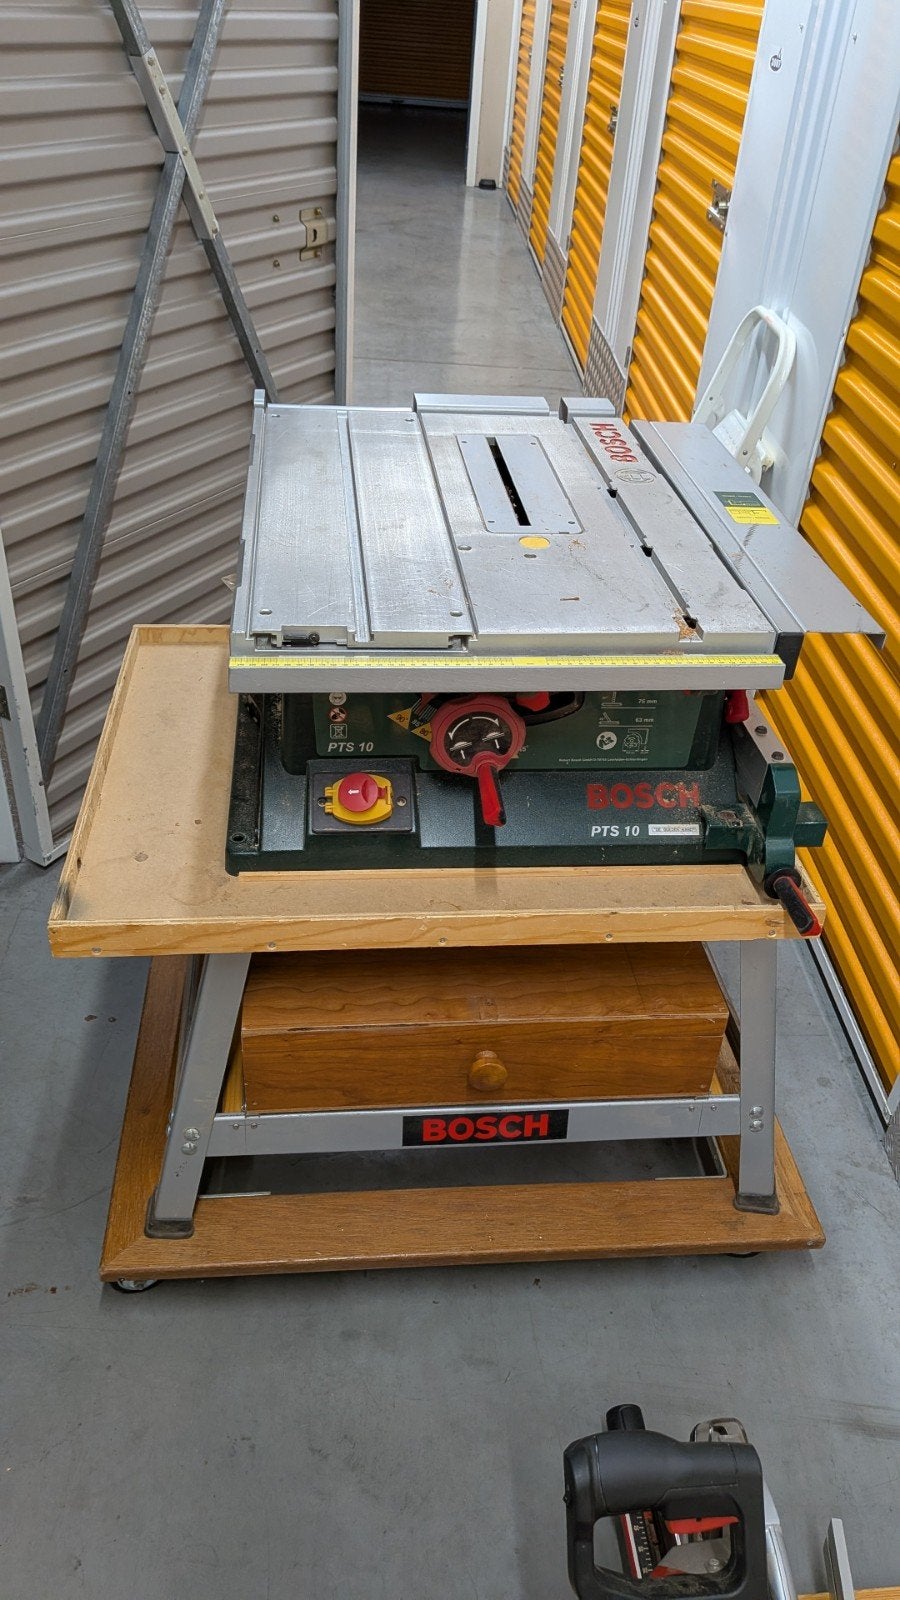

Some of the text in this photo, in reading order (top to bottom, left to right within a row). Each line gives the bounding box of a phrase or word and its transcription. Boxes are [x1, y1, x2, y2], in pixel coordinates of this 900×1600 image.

[590, 423, 638, 462] BOSCH
[327, 741, 375, 753] PTS 10
[586, 783, 700, 809] BOSCH
[590, 825, 620, 838] PTS
[624, 825, 640, 837] 10
[422, 1113, 549, 1142] BOSCH
